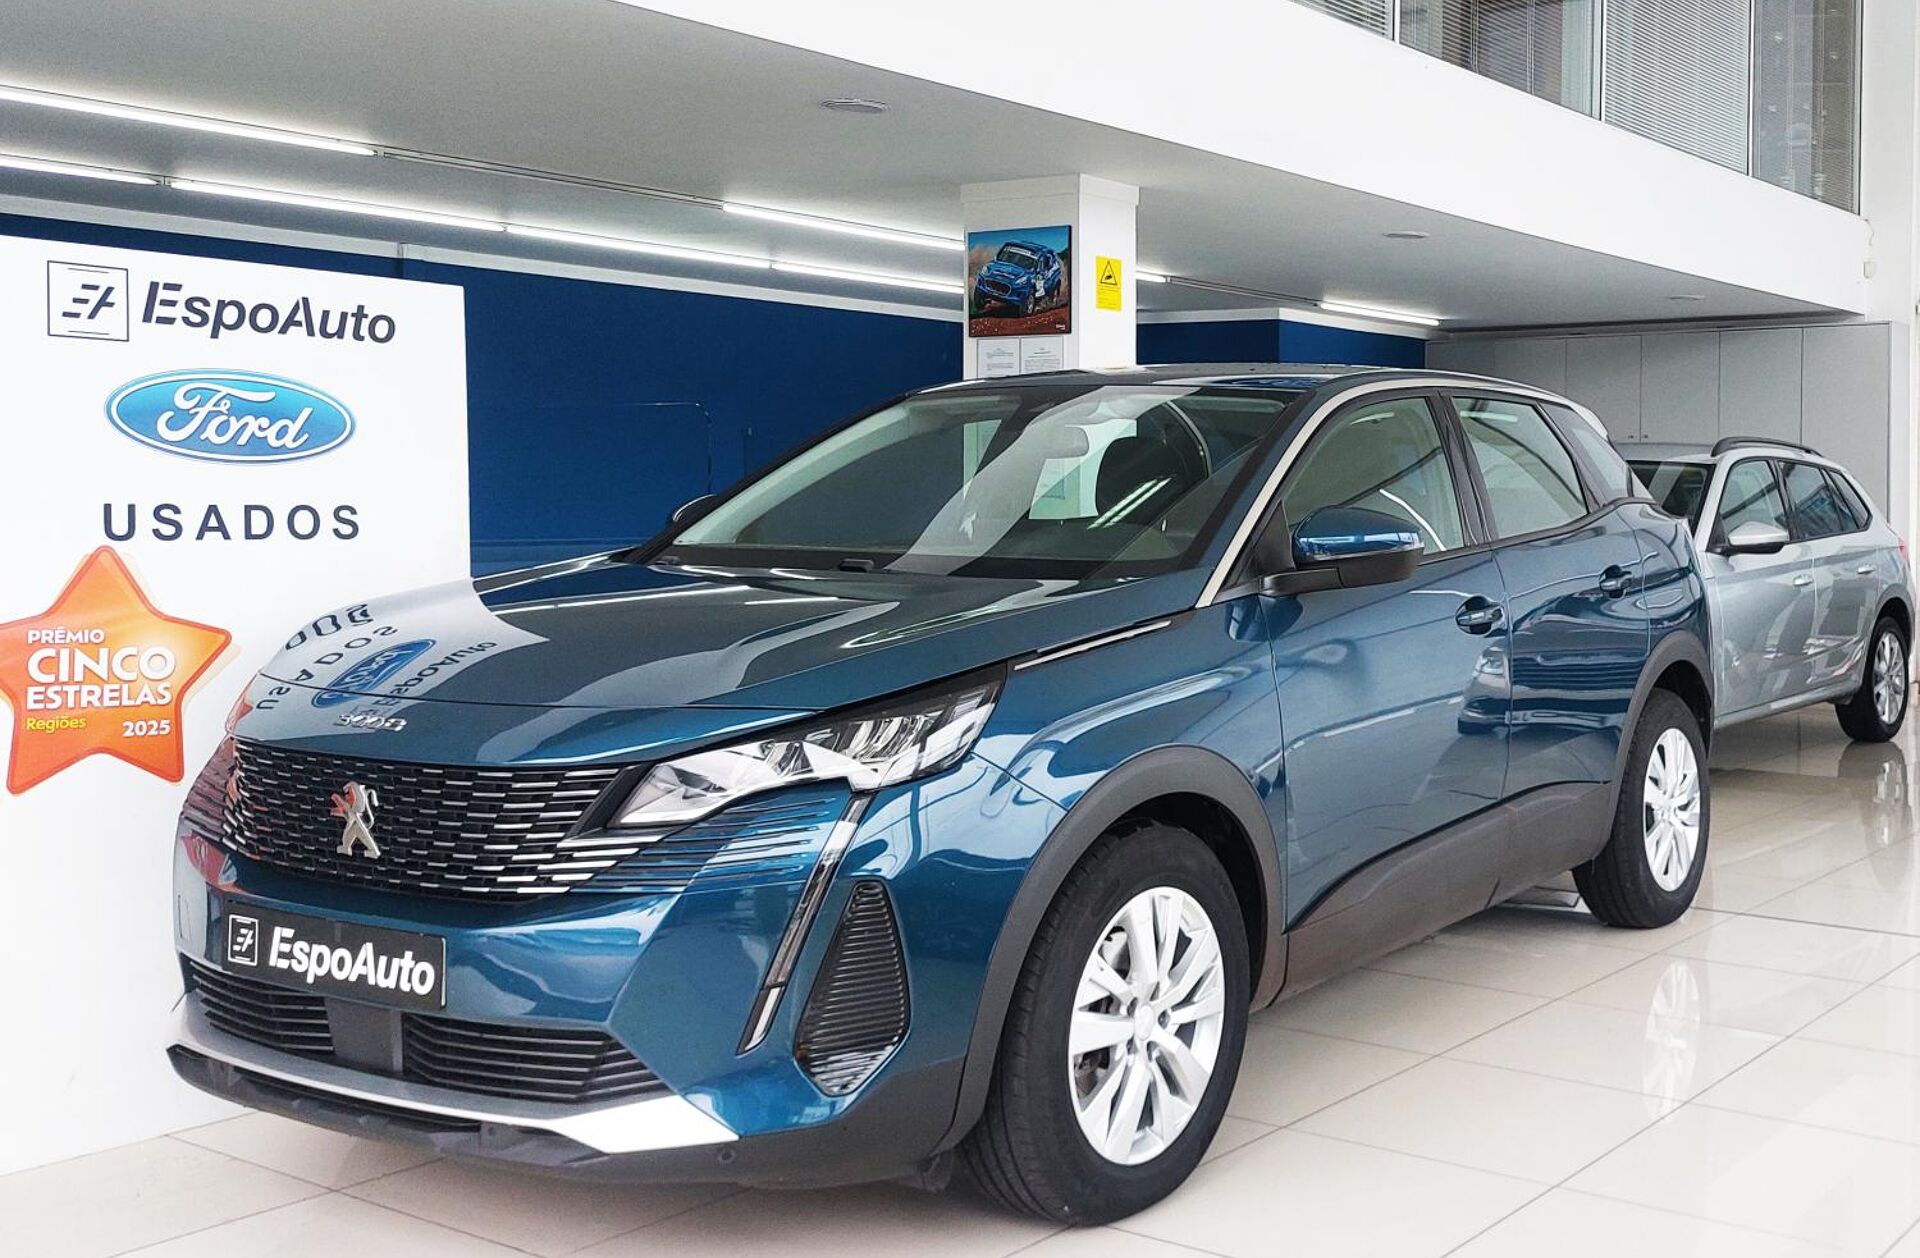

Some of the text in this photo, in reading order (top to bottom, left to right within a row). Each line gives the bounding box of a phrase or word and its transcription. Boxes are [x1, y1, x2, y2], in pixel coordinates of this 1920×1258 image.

[142, 280, 396, 344] EspoAuto
[156, 382, 314, 450] Ford
[103, 503, 359, 541] USADOS
[27, 626, 105, 644] PRÉMIO
[27, 648, 176, 684] CINCO
[26, 683, 172, 711] ESTRELAS
[26, 715, 87, 733] Regiões
[123, 720, 170, 737] 2025
[268, 926, 436, 996] EspoAuto
